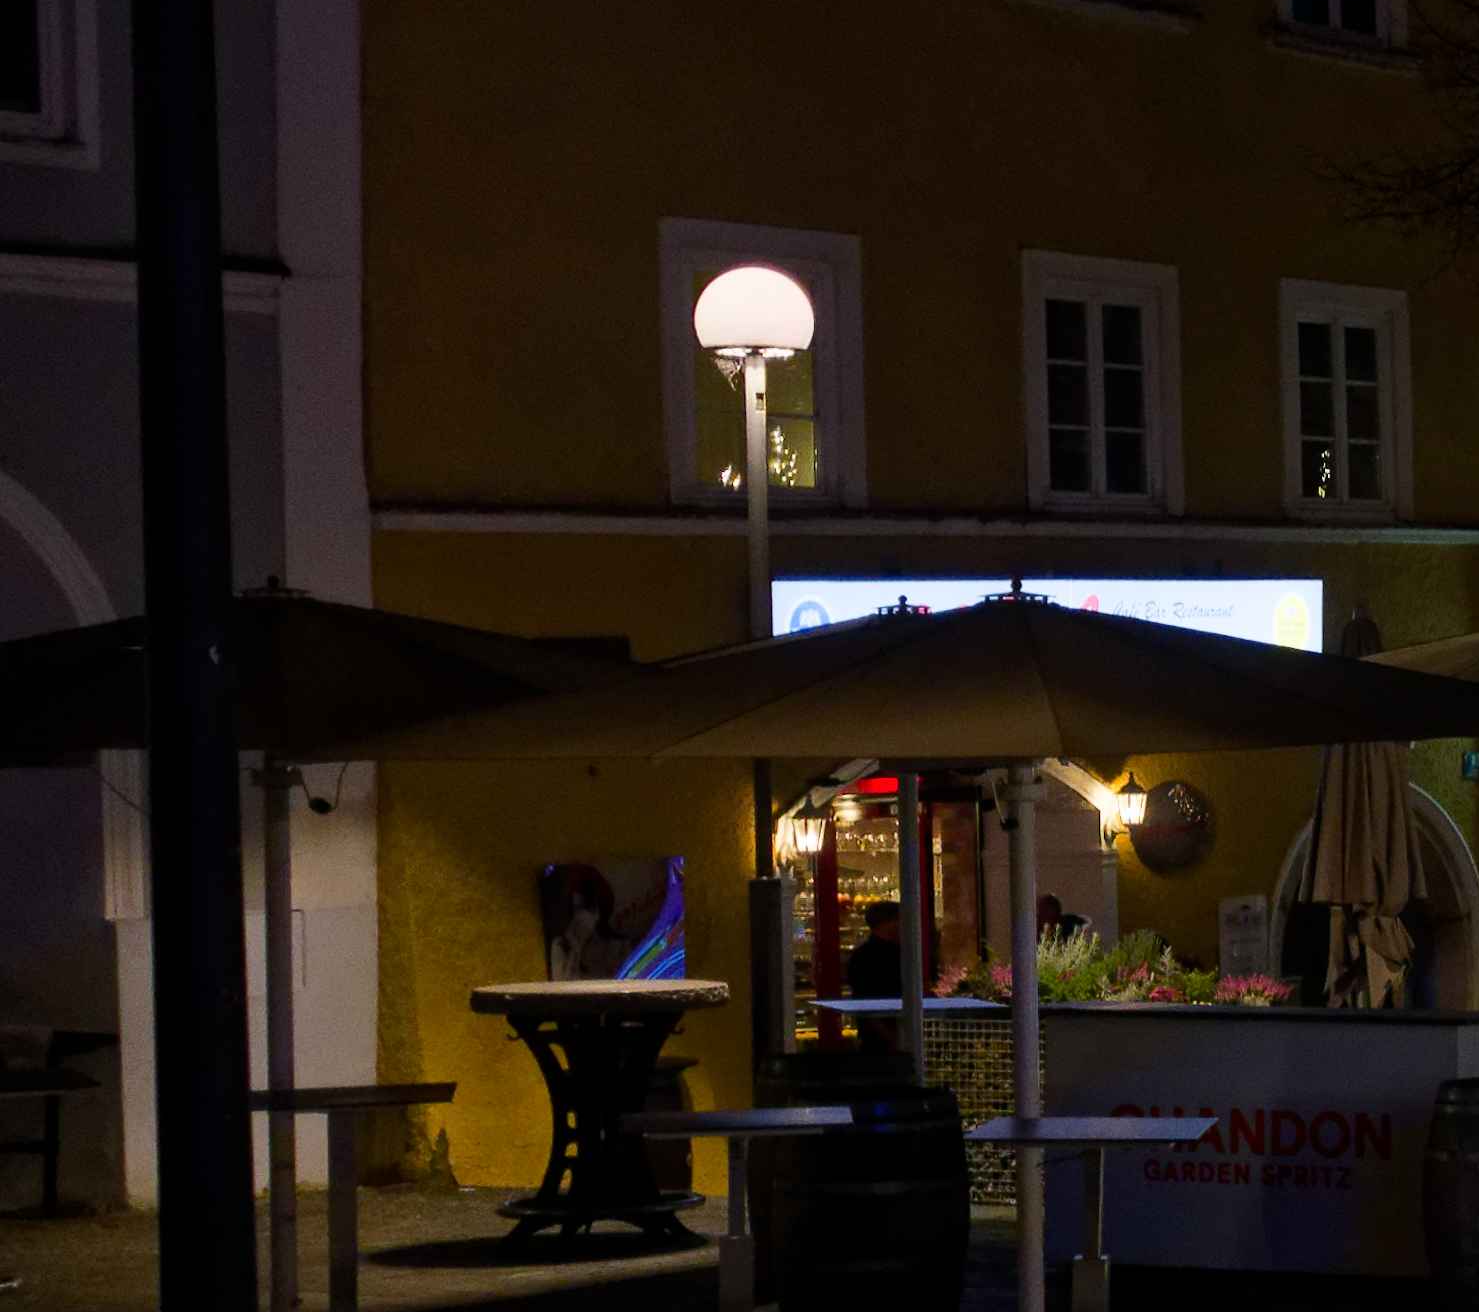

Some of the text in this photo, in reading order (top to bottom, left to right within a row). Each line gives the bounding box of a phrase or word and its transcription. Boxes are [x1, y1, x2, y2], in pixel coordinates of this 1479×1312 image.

[1111, 1105, 1392, 1160] ANDON
[1143, 1159, 1353, 1190] GARDEN SPRITZ
